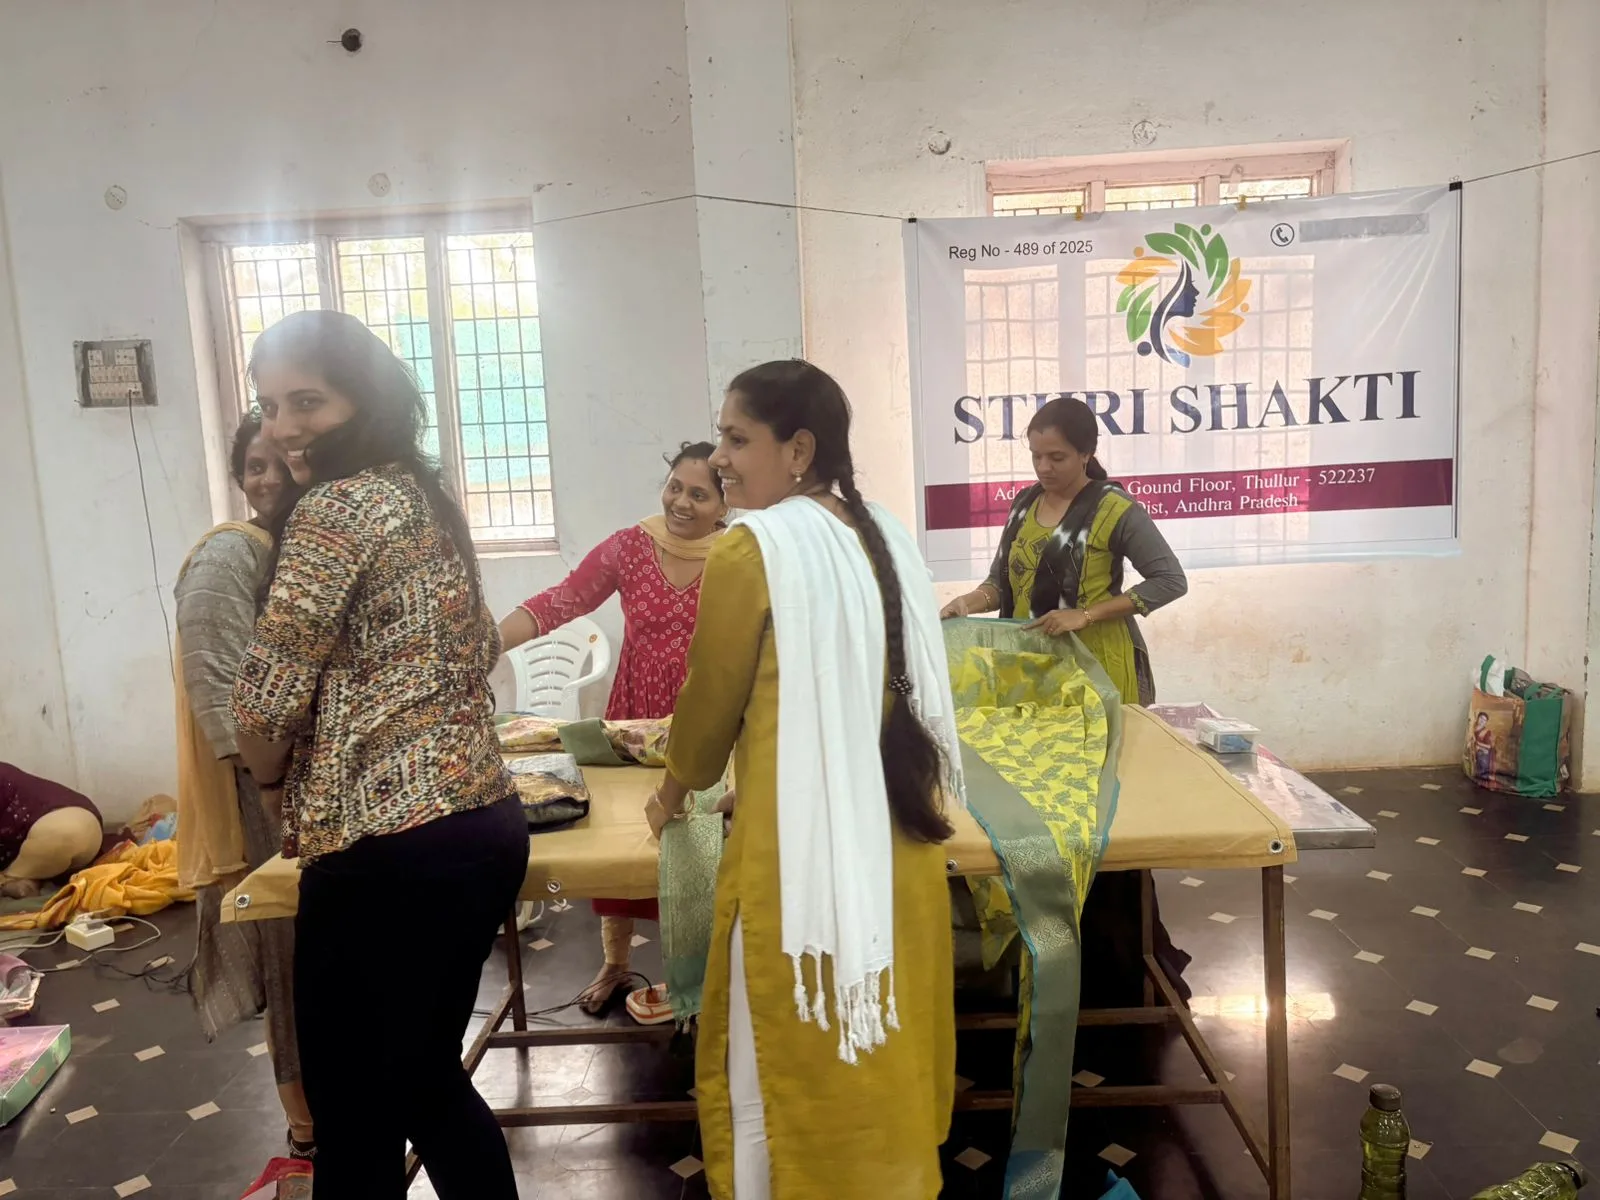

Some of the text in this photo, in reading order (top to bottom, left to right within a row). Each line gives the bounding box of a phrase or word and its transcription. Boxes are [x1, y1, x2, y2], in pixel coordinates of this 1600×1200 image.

[949, 245, 977, 261] Reg
[981, 244, 1001, 257] No
[1013, 242, 1039, 256] 489
[1043, 241, 1056, 255] of
[1059, 240, 1093, 254] 2025
[954, 370, 1421, 444] STRI SHAKTI
[1127, 479, 1182, 496] Gound
[1189, 477, 1236, 493] Floor,
[1243, 473, 1300, 490] Thullur
[1318, 468, 1376, 485] 522237
[1174, 497, 1232, 514] Andhra
[1240, 493, 1299, 510] Pradesh
